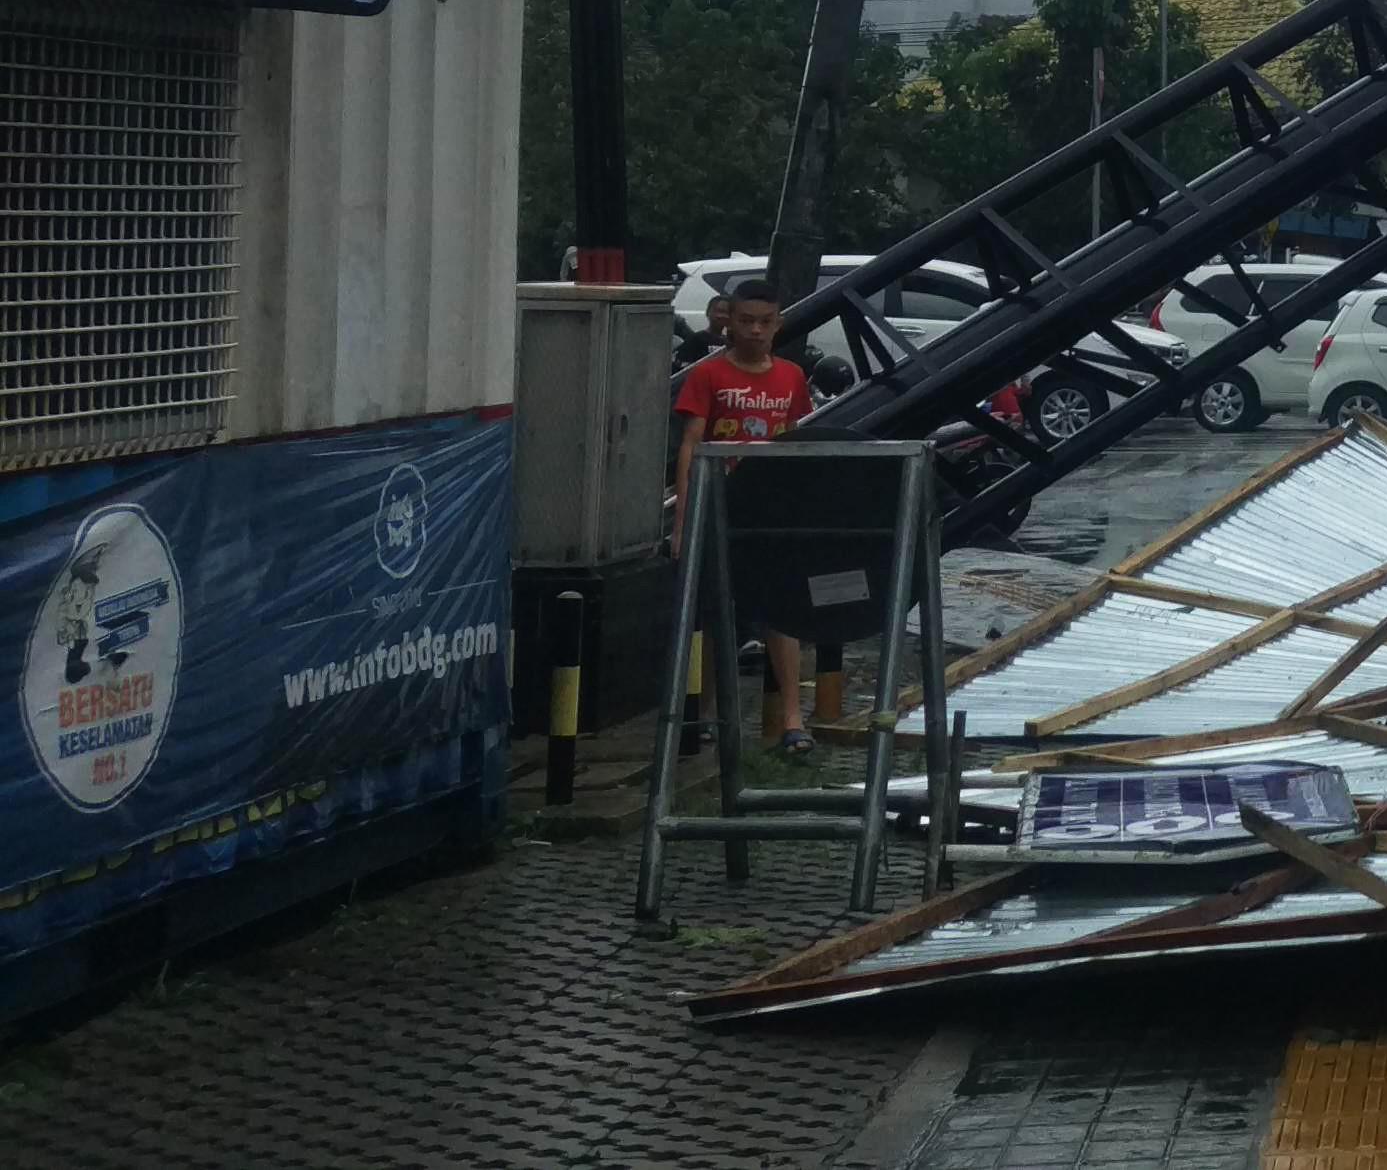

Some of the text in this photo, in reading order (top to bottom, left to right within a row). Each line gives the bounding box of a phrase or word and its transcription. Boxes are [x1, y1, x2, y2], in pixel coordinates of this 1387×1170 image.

[717, 386, 792, 409] Thailand
[284, 622, 496, 708] www.infobdg.com
[58, 672, 153, 727] BERSATU
[59, 712, 152, 759] KESELAMATAN
